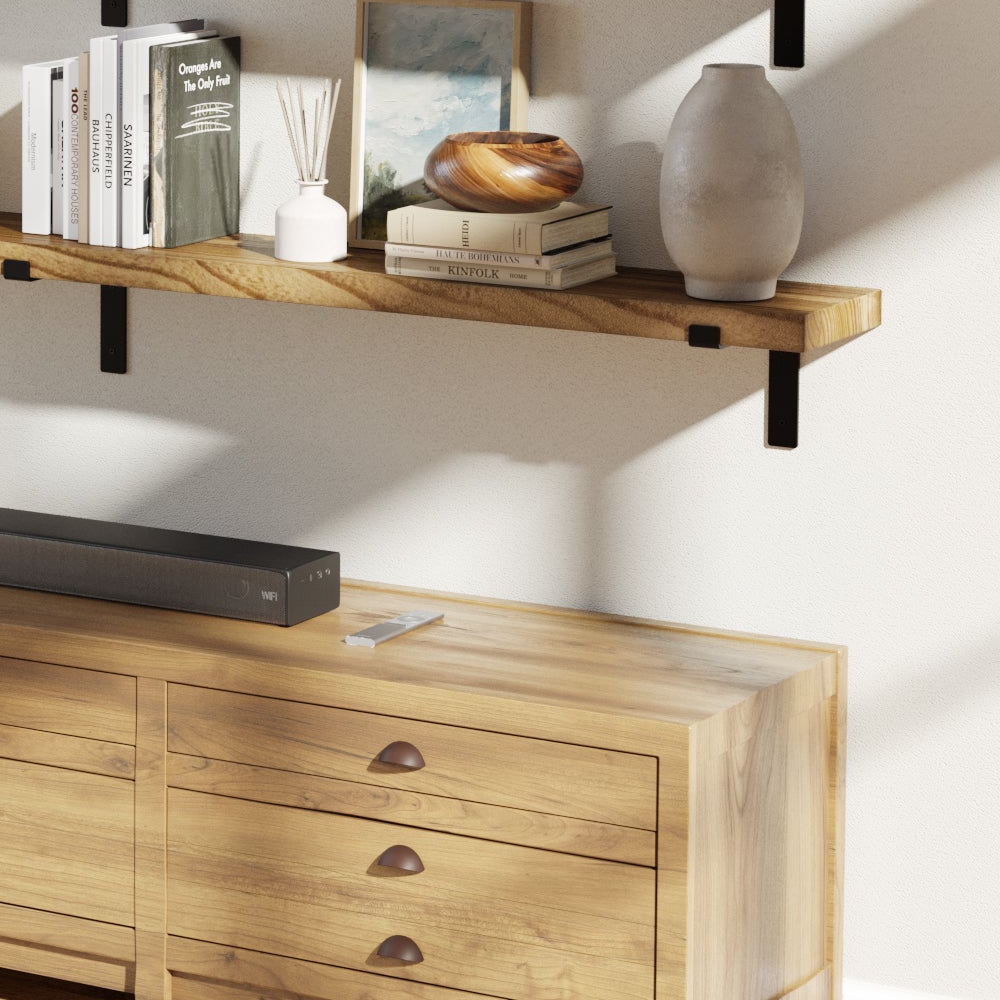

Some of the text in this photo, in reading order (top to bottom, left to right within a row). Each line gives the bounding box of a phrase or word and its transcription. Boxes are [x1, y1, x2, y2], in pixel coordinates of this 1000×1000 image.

[179, 59, 222, 76] Oranges Are
[184, 74, 231, 92] The Only Fruit
[92, 119, 100, 173] BAUHAUS
[105, 113, 113, 189] CHIPPERFIELD
[123, 124, 132, 187] SAARINEN
[436, 249, 466, 260] HAUTE
[468, 252, 520, 264] BOHEMIANS
[428, 265, 441, 273] THE
[448, 265, 500, 280] KINFOLK
